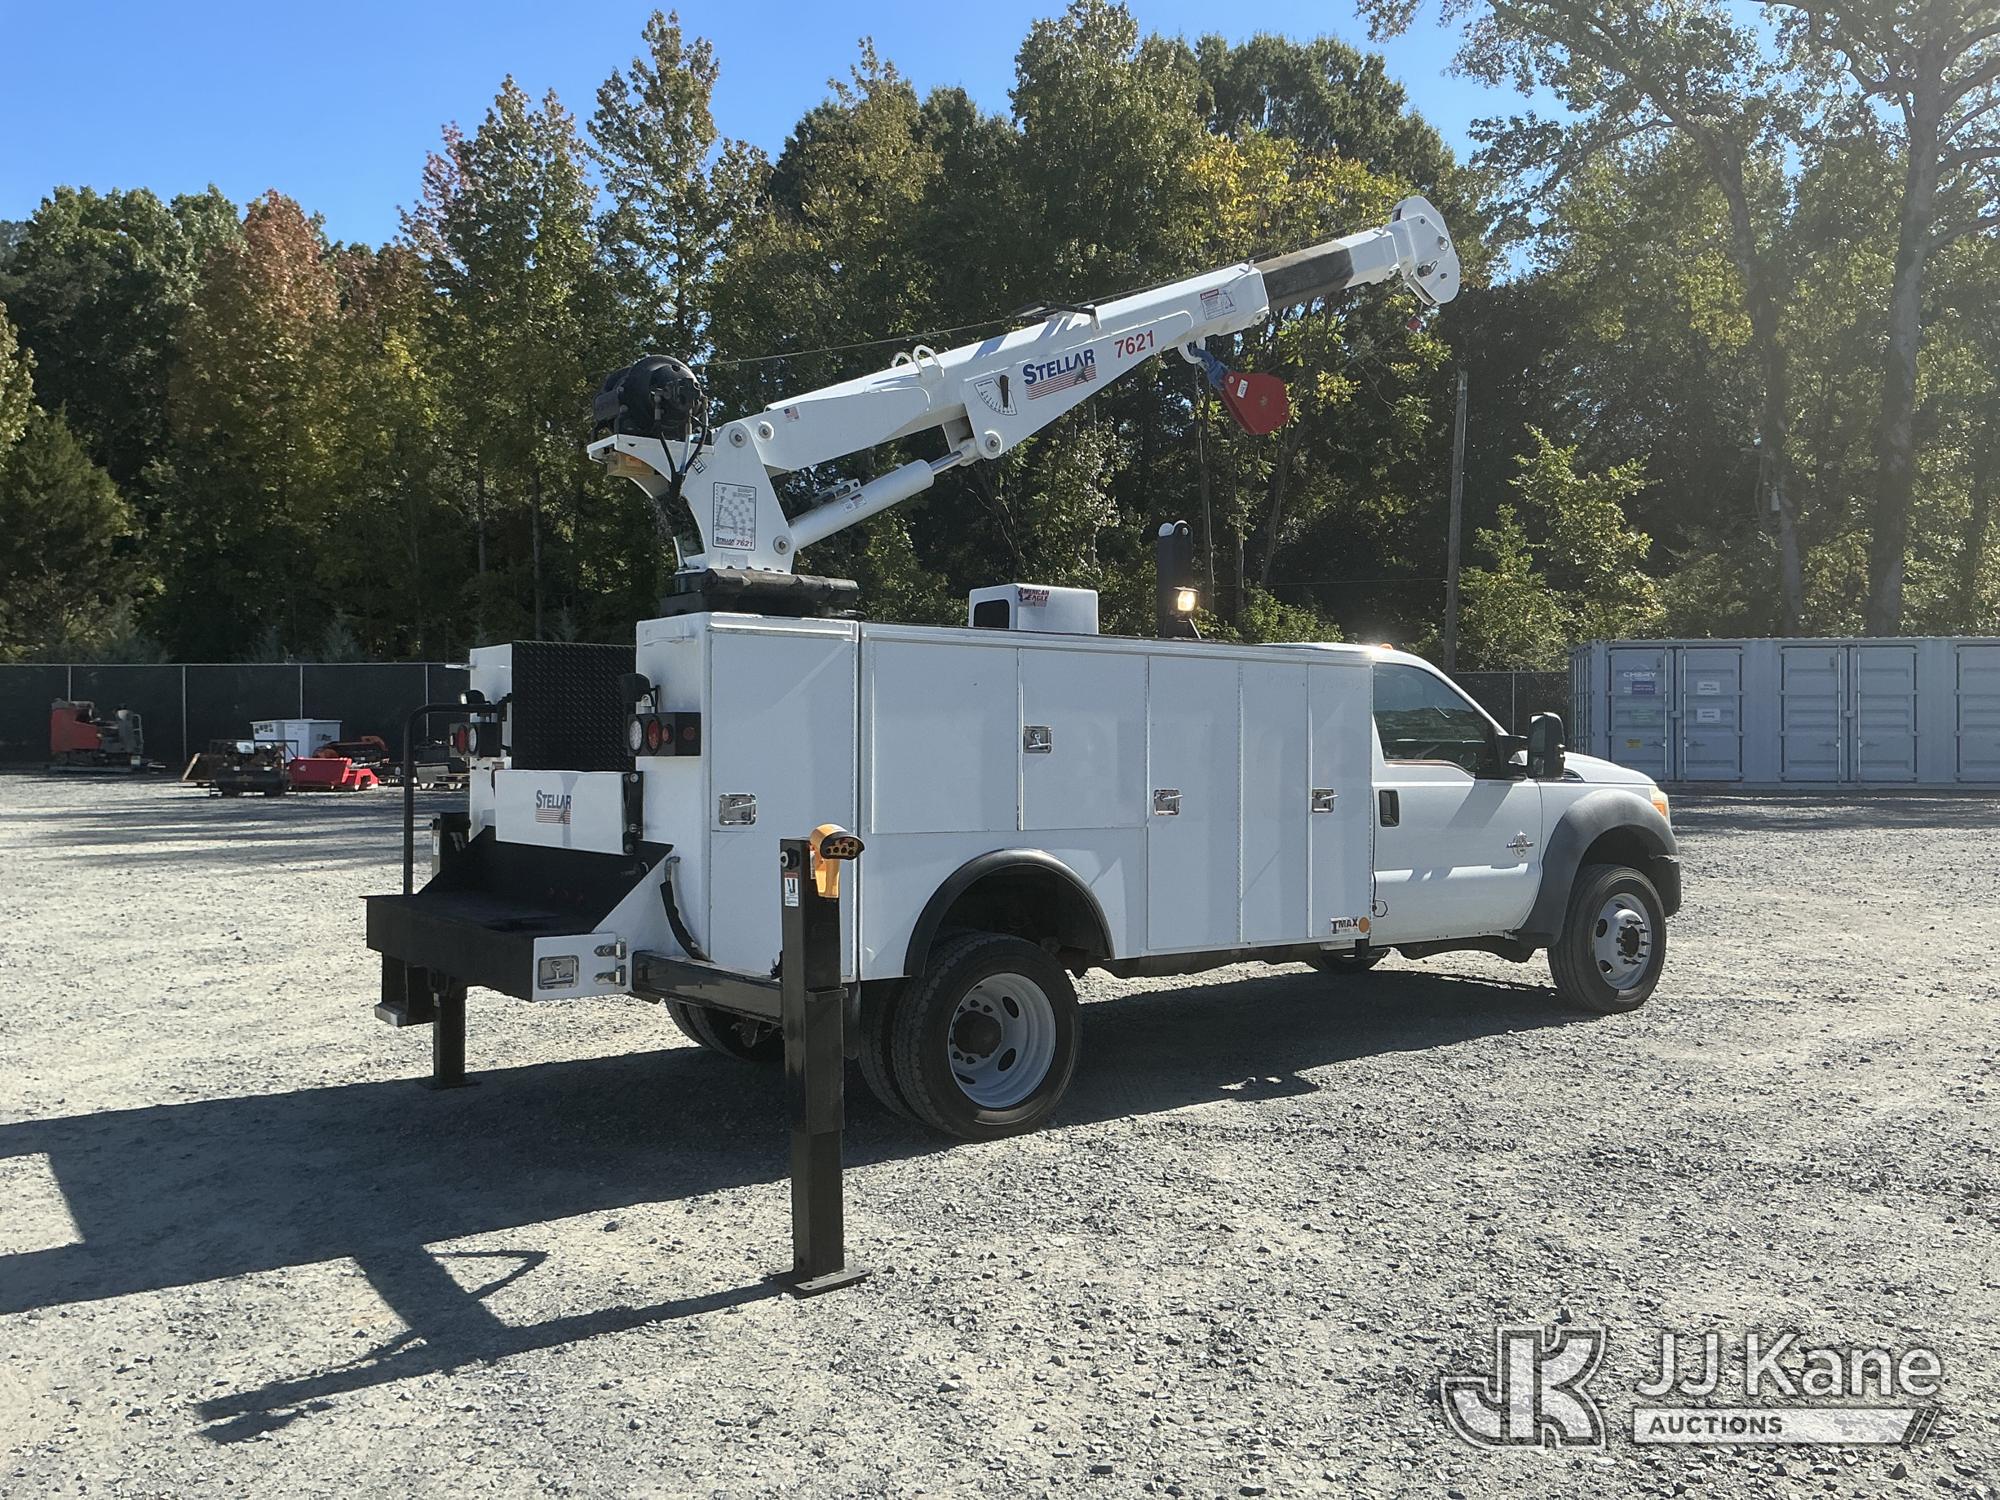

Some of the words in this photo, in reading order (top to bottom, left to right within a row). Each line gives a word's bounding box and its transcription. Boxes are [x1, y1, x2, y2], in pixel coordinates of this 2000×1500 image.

[1114, 330, 1155, 358] 7621
[1022, 349, 1095, 385] STELLAR
[736, 539, 753, 547] 7621
[536, 789, 571, 810] STELLAR
